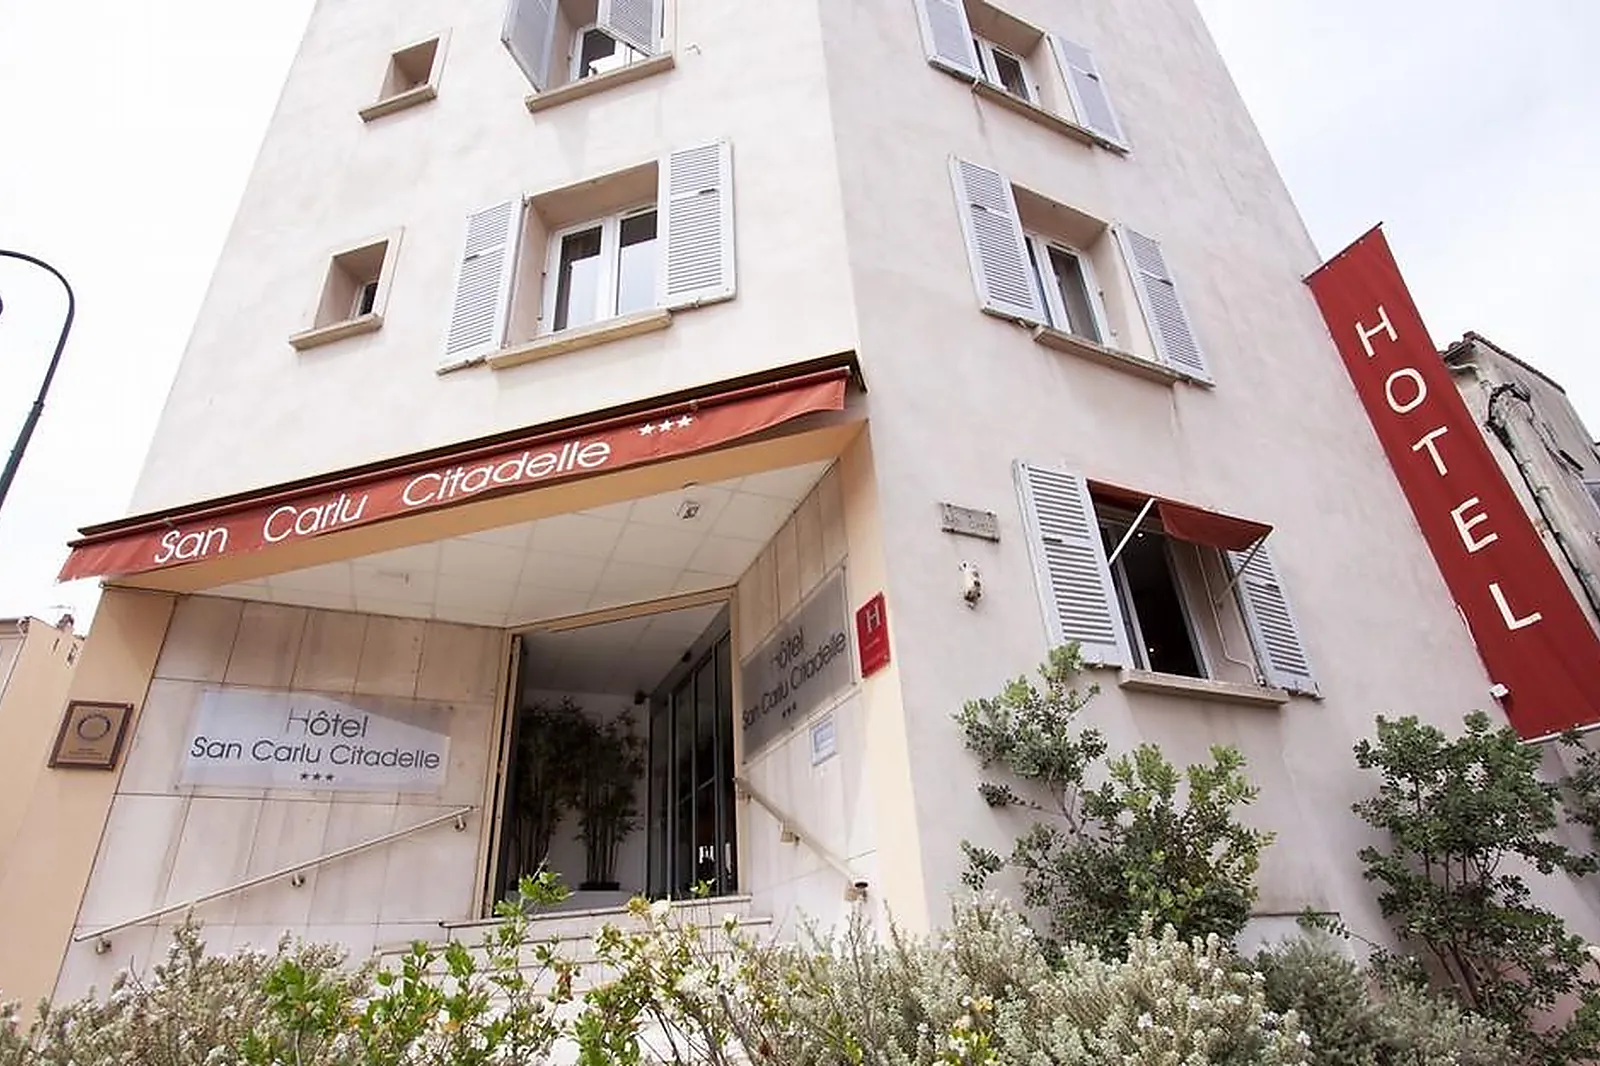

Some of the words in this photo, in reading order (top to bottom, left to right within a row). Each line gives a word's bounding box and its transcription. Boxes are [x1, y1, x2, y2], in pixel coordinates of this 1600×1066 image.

[154, 525, 230, 563] San
[263, 493, 369, 543] Carlu
[402, 440, 611, 507] Citadelle
[1355, 305, 1543, 631] HOTEL
[190, 736, 242, 760] San
[251, 738, 323, 765] Carlu
[329, 743, 441, 770] Citadelle
[286, 706, 369, 738] Hôtel
